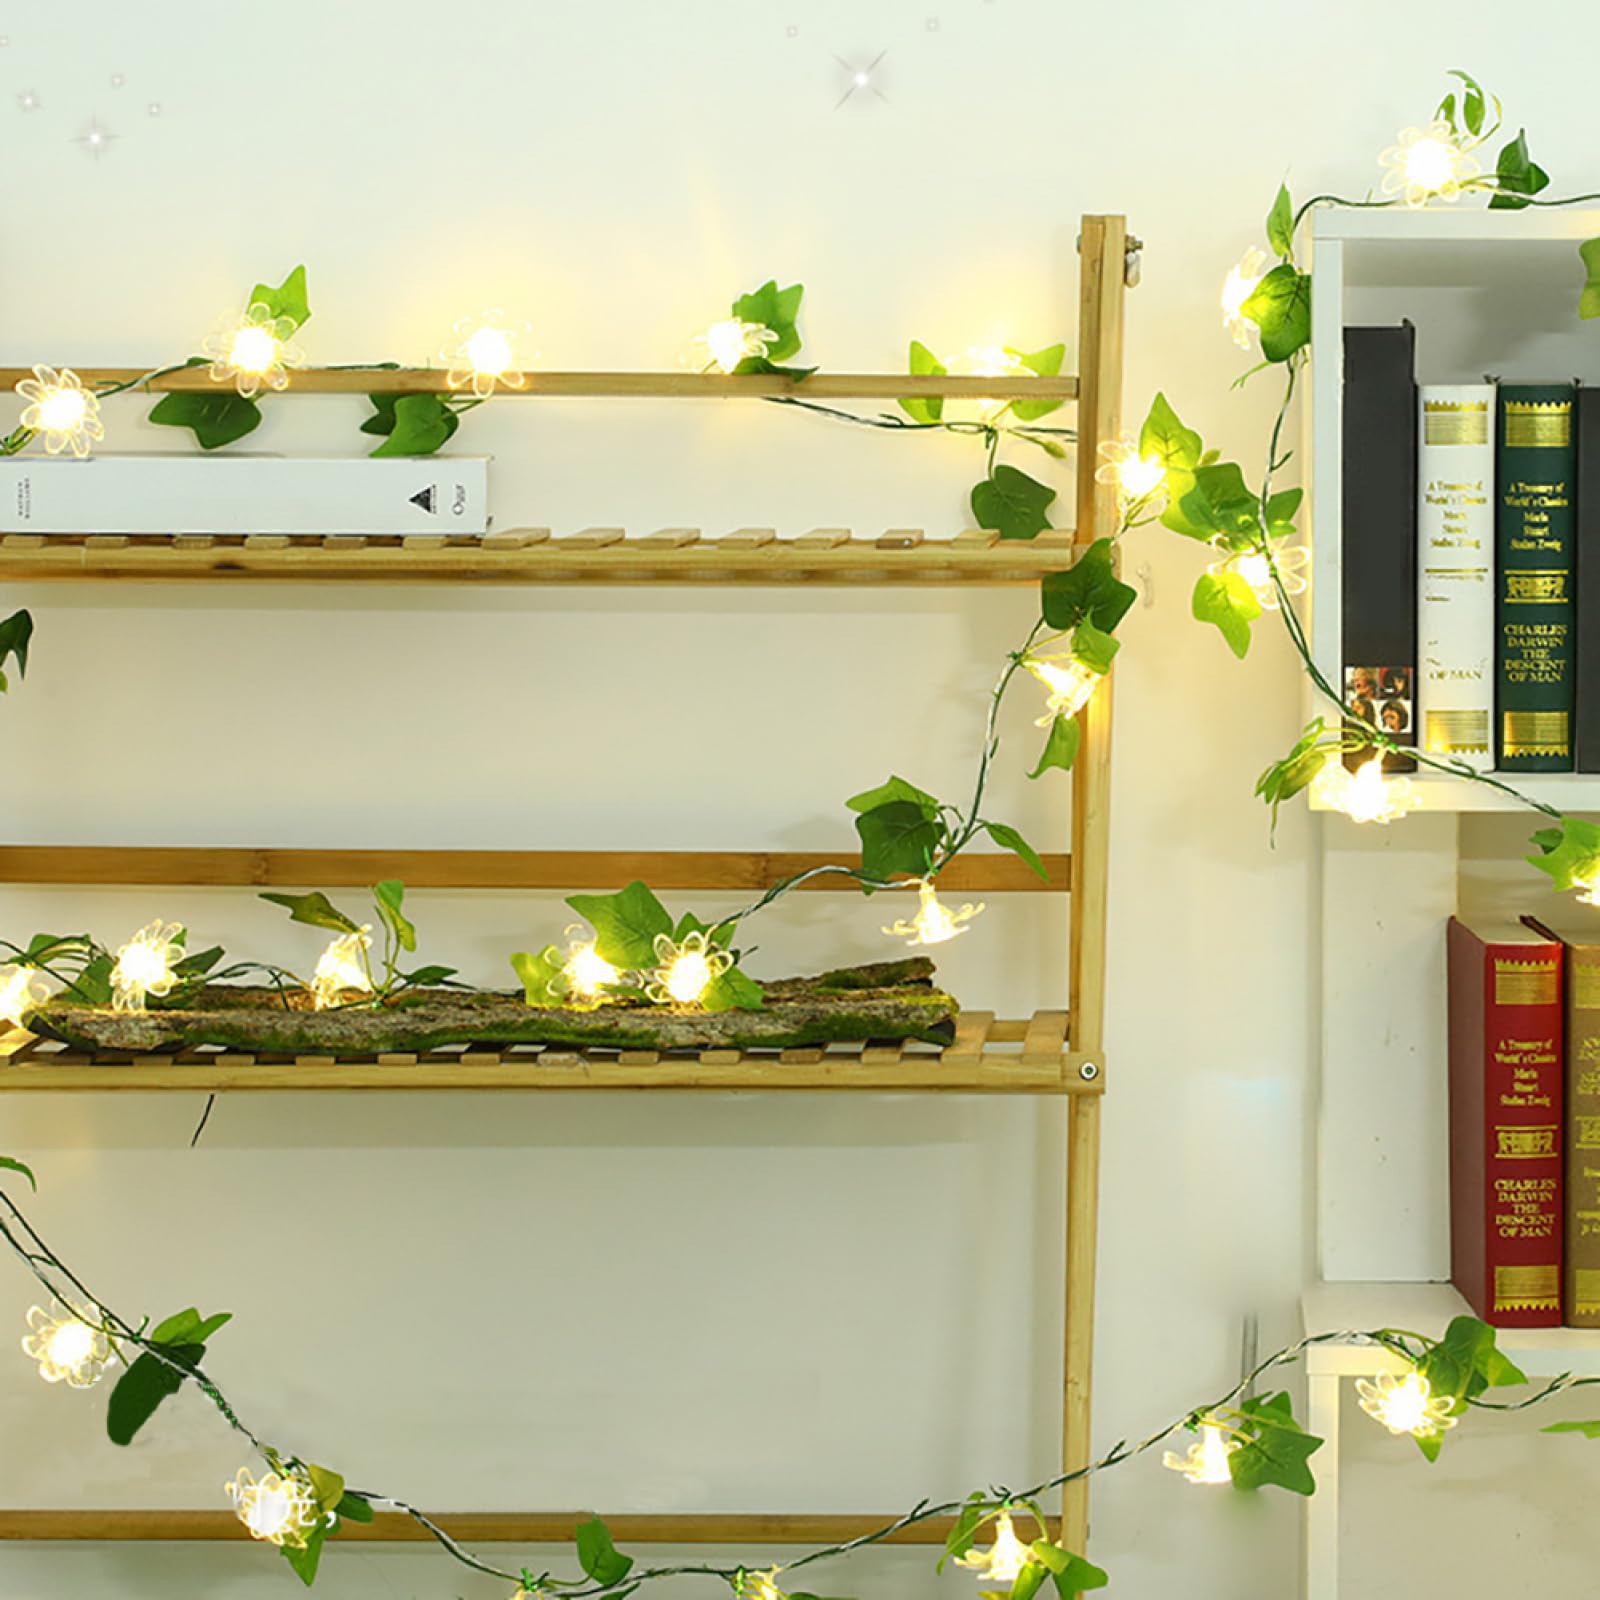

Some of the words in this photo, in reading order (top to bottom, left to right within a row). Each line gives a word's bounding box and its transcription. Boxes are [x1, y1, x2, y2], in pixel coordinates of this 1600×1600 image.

[1504, 624, 1568, 635] CHARLES
[1507, 637, 1564, 648] DARWIN
[1521, 649, 1550, 659] THE
[1504, 660, 1567, 671] DESCENT
[1508, 672, 1526, 682] OF
[1529, 672, 1562, 682] MAN
[1494, 1179, 1557, 1190] CHARLES
[1498, 1192, 1553, 1202] DARWIN
[1513, 1204, 1539, 1214] THE
[1495, 1214, 1556, 1225] DESCENT
[1499, 1226, 1518, 1237] OF
[1520, 1226, 1552, 1237] MAN
